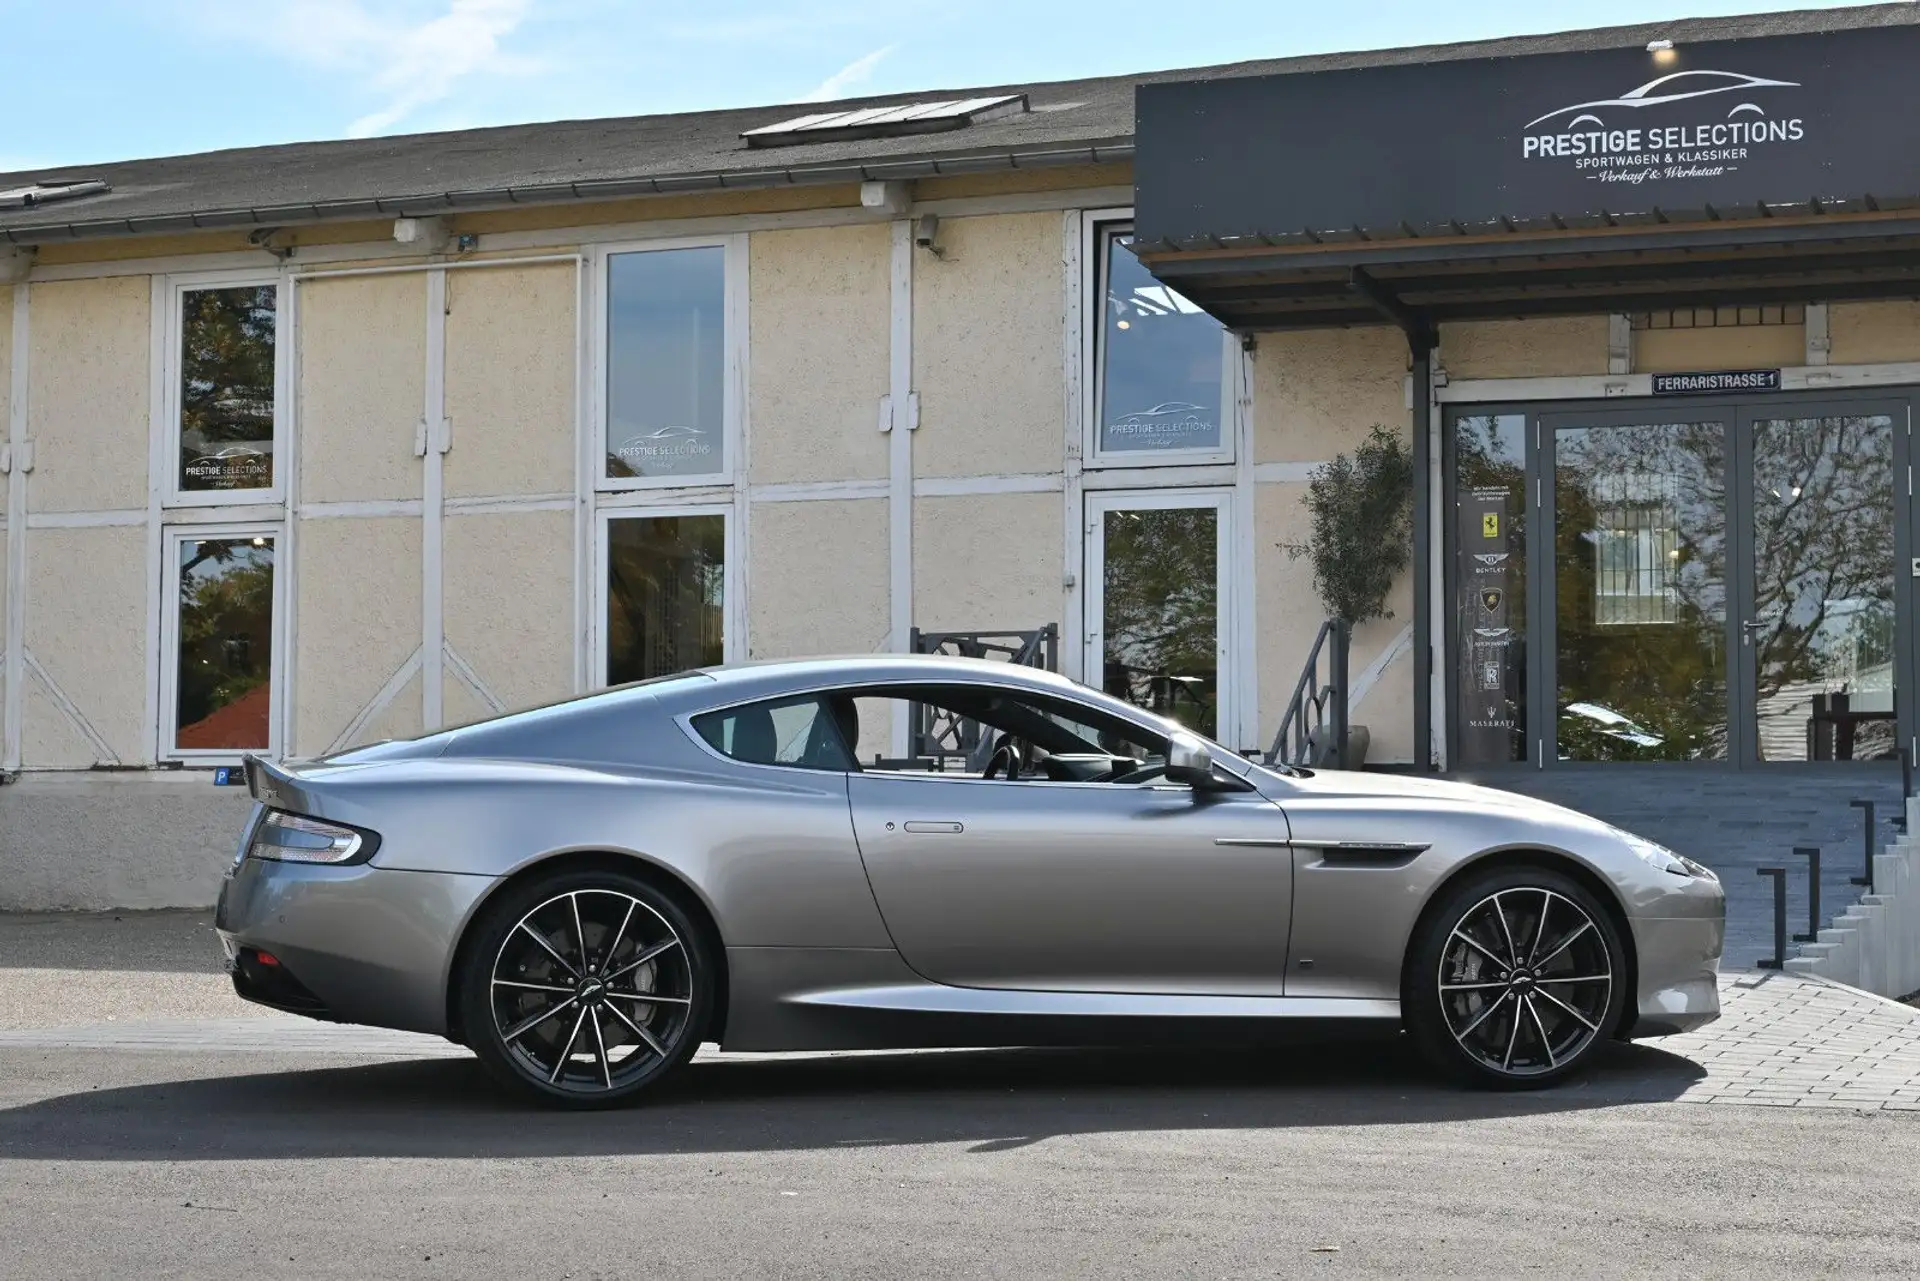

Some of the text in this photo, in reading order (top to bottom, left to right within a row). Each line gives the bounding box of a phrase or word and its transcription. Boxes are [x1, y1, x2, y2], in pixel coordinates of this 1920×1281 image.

[1523, 119, 1804, 158] PRESTIGE SELECTIONS
[1575, 148, 1747, 169] SPORTWAGEN & KLASSIKER
[1599, 165, 1724, 184] Verkauf & Werkstatt
[1658, 373, 1774, 390] FERRARISTRASSE 1
[1110, 423, 1153, 434] PRESTIGE
[620, 447, 657, 457] PRESTIGE
[185, 464, 268, 475] PRESTIGE SELECTIONS
[218, 771, 226, 782] P
